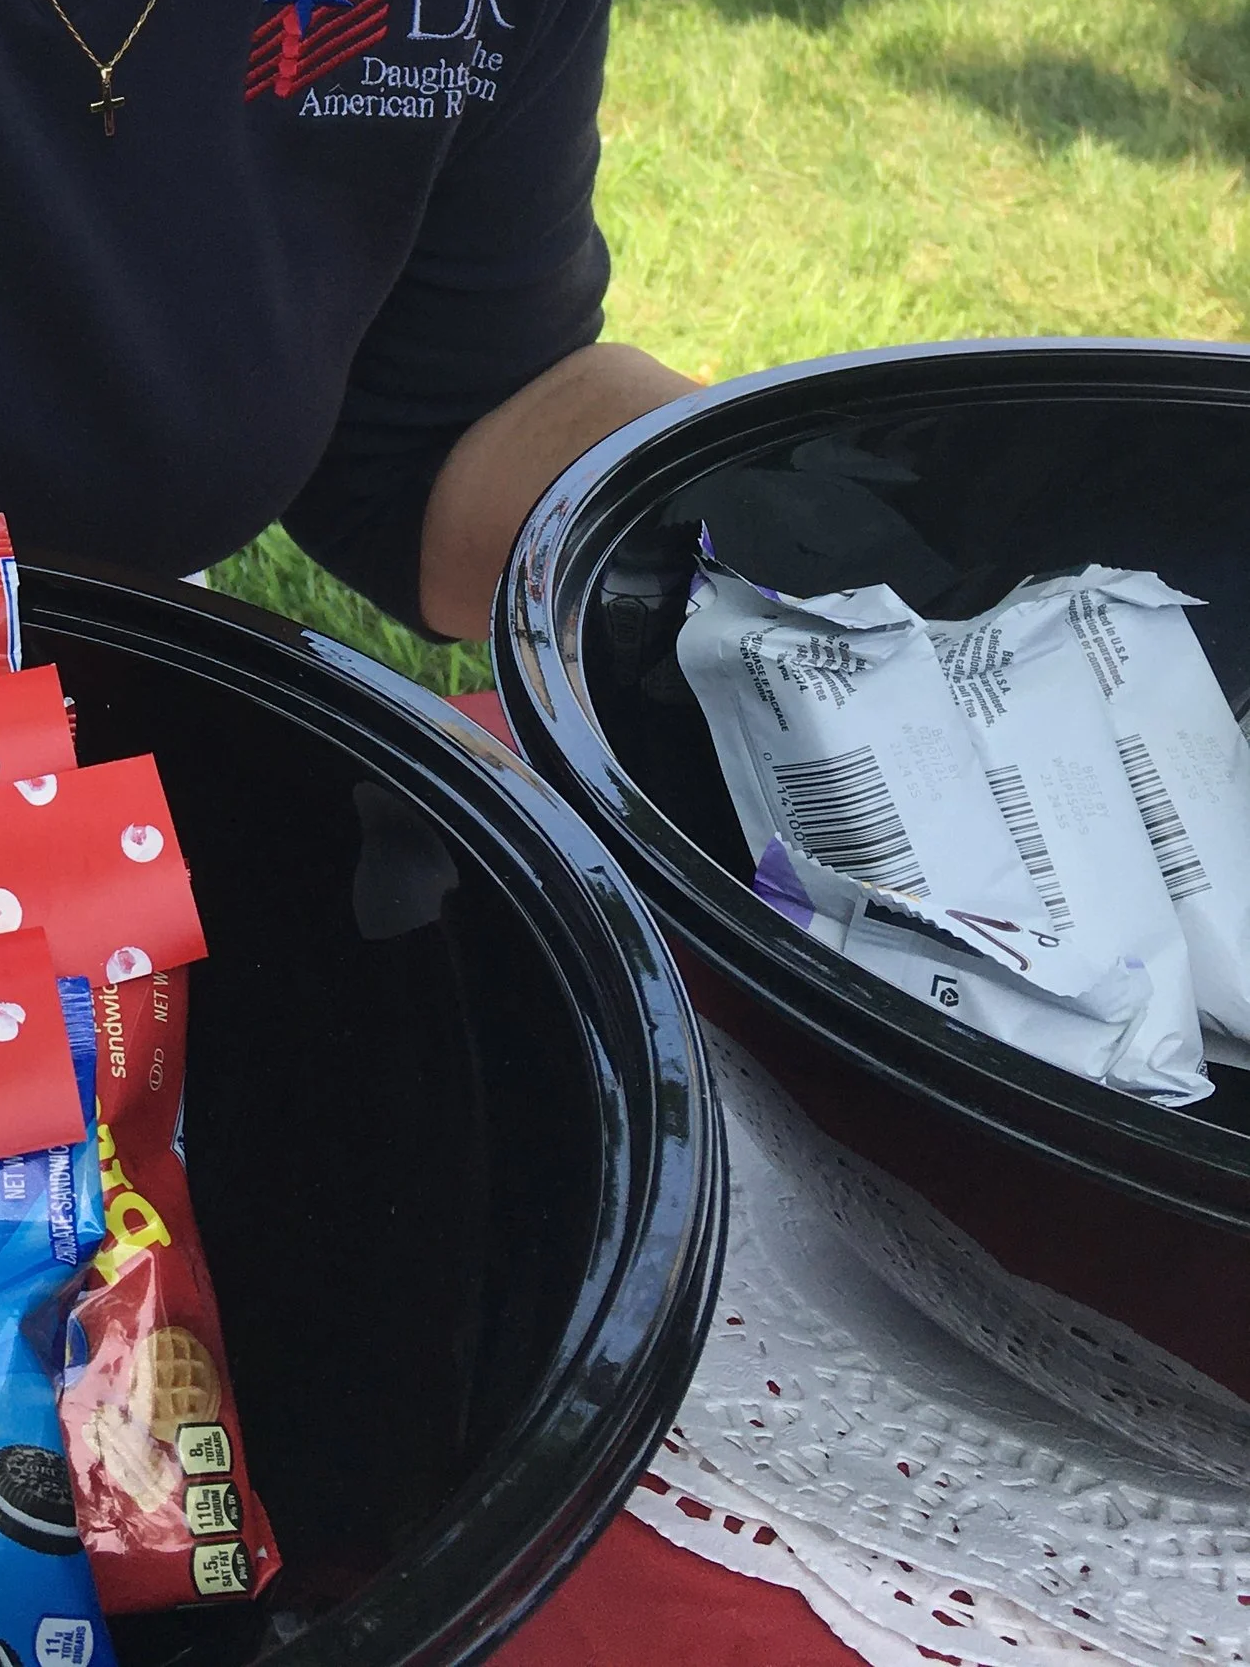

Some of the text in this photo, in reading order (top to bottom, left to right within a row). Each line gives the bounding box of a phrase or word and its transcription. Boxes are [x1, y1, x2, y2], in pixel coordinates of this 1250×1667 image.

[361, 40, 503, 95] Daught he
[298, 87, 434, 119] American
[1081, 639, 1092, 650] or
[1105, 626, 1116, 637] in
[1092, 636, 1126, 689] guaranteed.
[1110, 636, 1130, 666] U.S.A.
[745, 661, 755, 675] OR
[752, 676, 769, 703] TORN
[777, 665, 790, 681] you
[992, 669, 1012, 696] U.S.A.
[1086, 651, 1116, 706] comments,
[813, 681, 828, 702] free
[963, 698, 978, 719] free
[968, 681, 996, 728] comments,
[765, 691, 790, 733] PACKAGE
[777, 786, 806, 841] 14100
[153, 971, 170, 986] W
[153, 990, 169, 1023] NET
[102, 983, 127, 1079] sandwic
[2, 1155, 27, 1200] NET W
[48, 1145, 74, 1215] SANDWIC
[203, 1436, 215, 1464] TOTAL
[212, 1431, 226, 1467] SUGARS
[210, 1489, 225, 1527] SODIUM
[218, 1550, 233, 1588] SAT FAT
[61, 1630, 75, 1660] TOTAL
